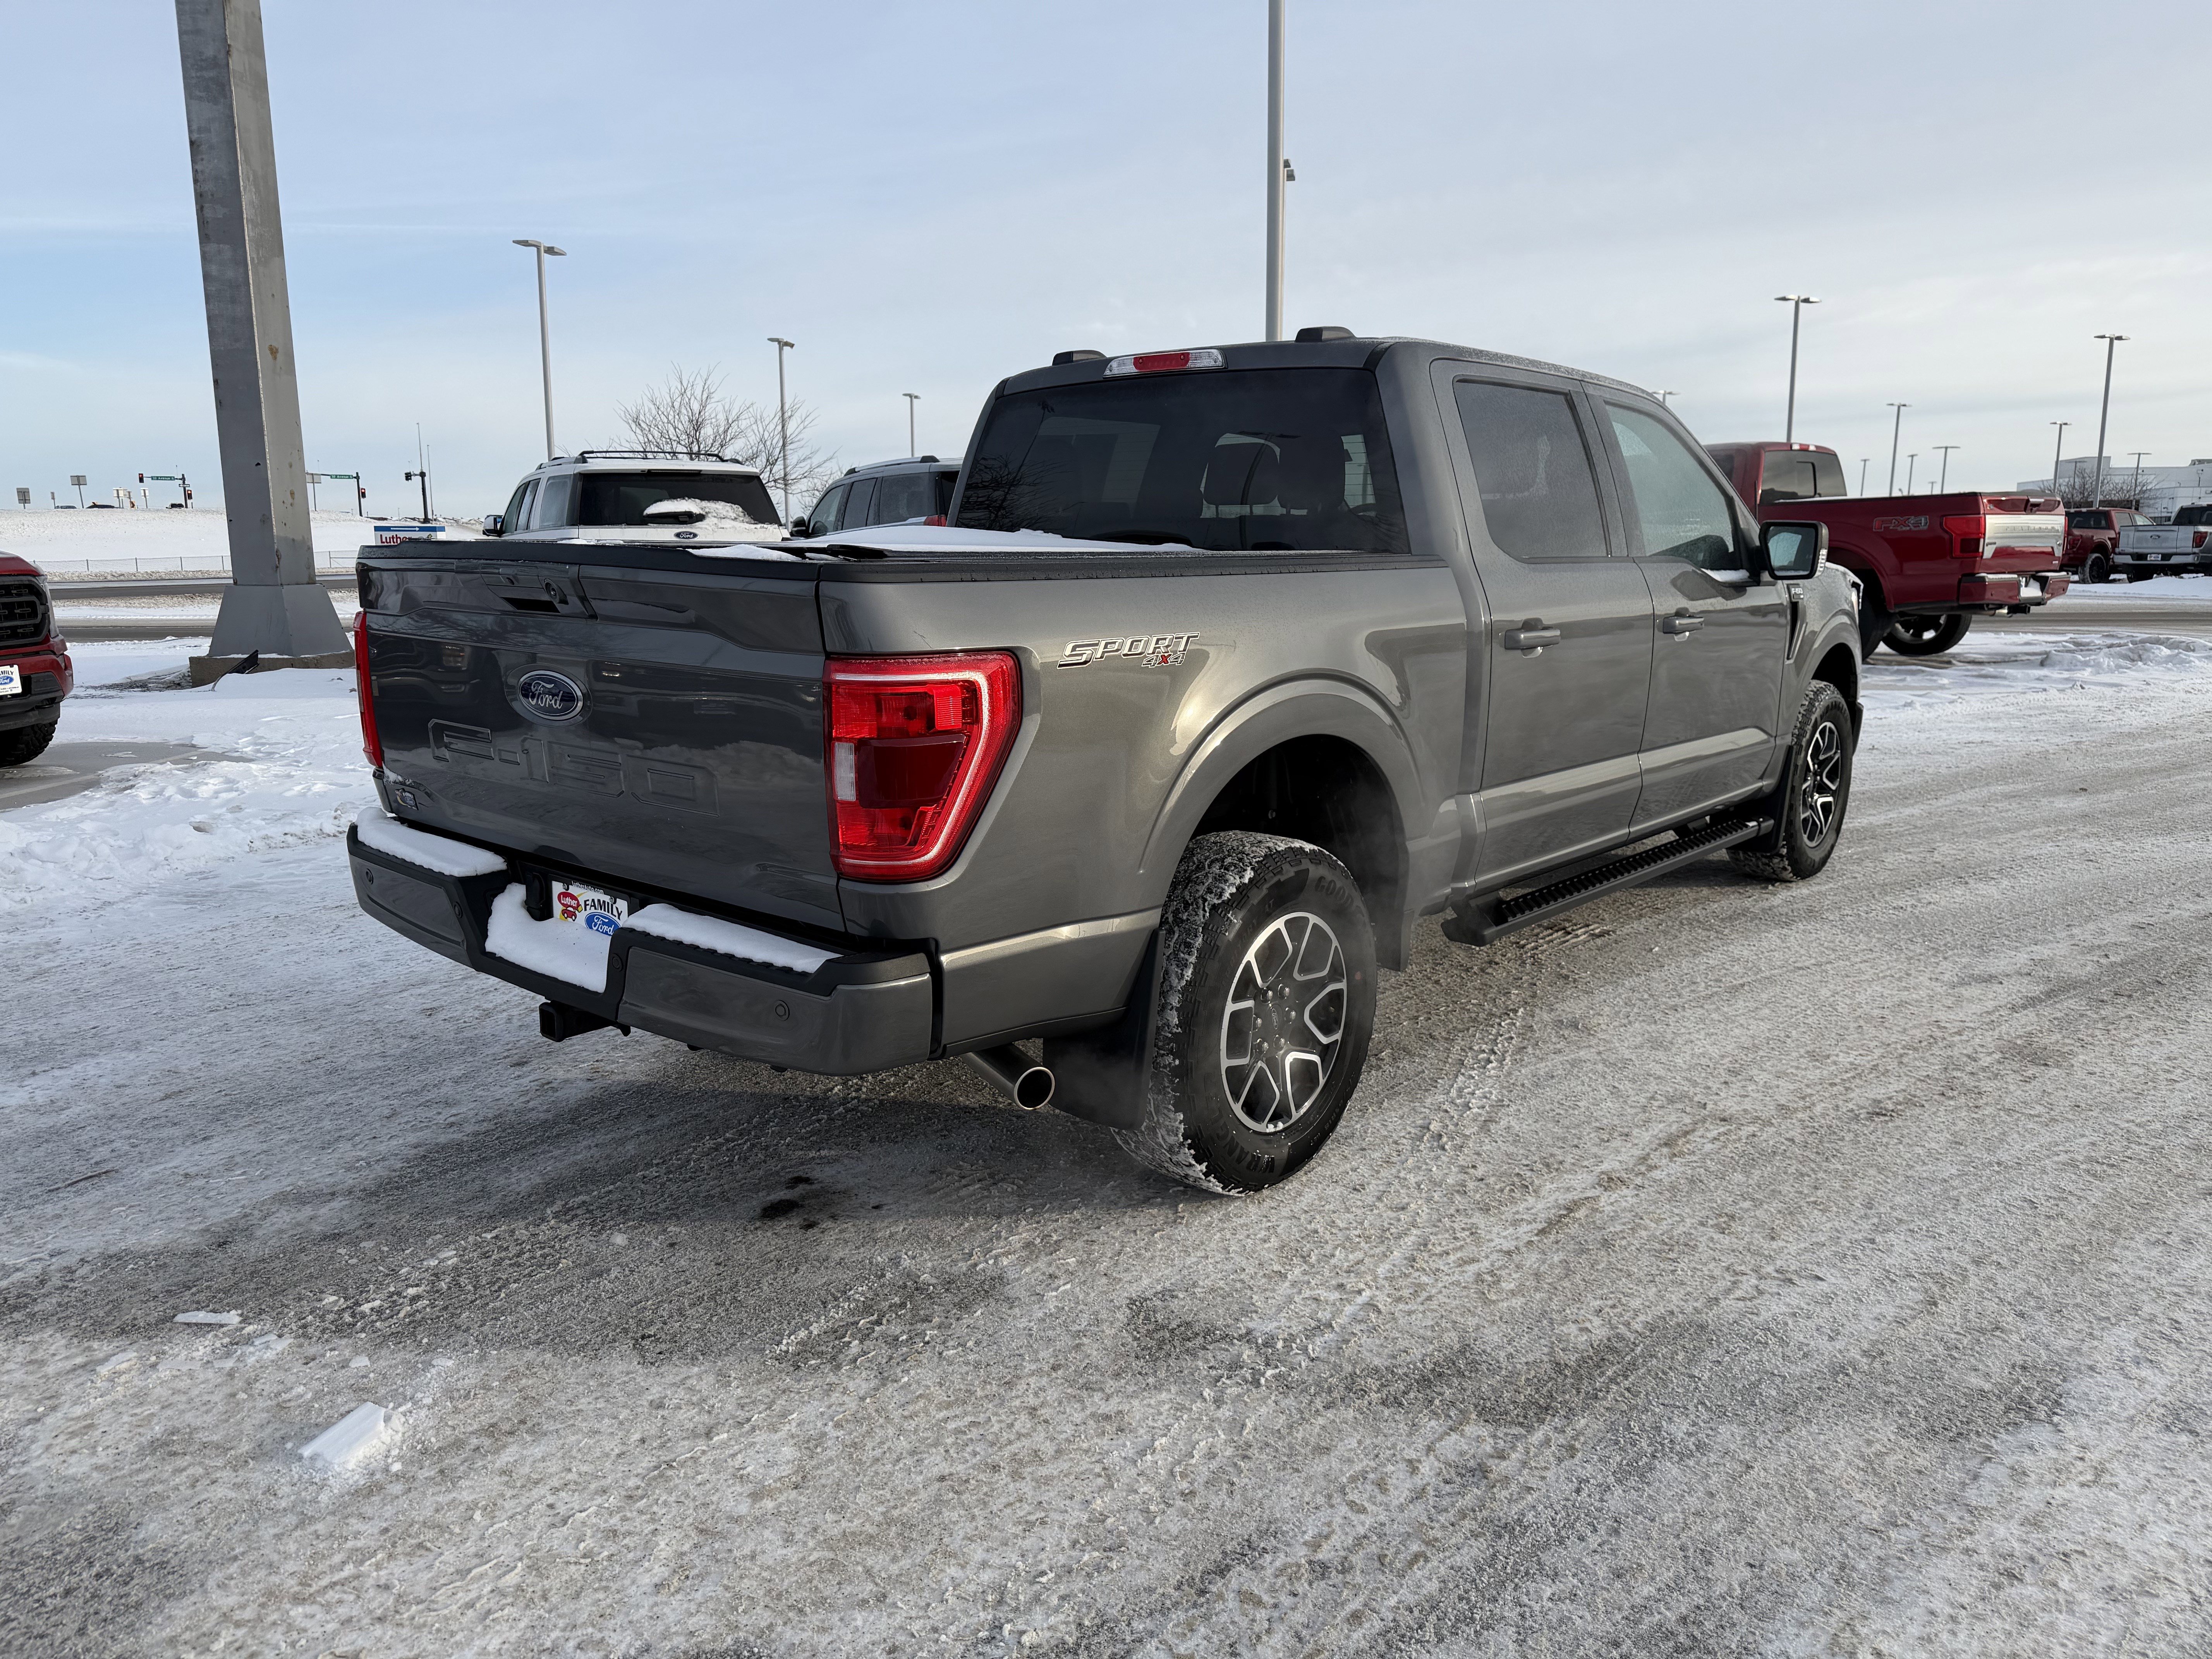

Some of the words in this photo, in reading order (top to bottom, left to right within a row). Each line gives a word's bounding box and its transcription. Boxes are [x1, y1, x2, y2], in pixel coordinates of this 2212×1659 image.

[1873, 515, 1929, 532] FX4
[1057, 632, 1200, 669] SPORT
[529, 680, 563, 709] Ford
[428, 718, 720, 817] F-150
[561, 895, 577, 907] Luther
[584, 898, 623, 921] FAMILY
[592, 915, 614, 935] Ford
